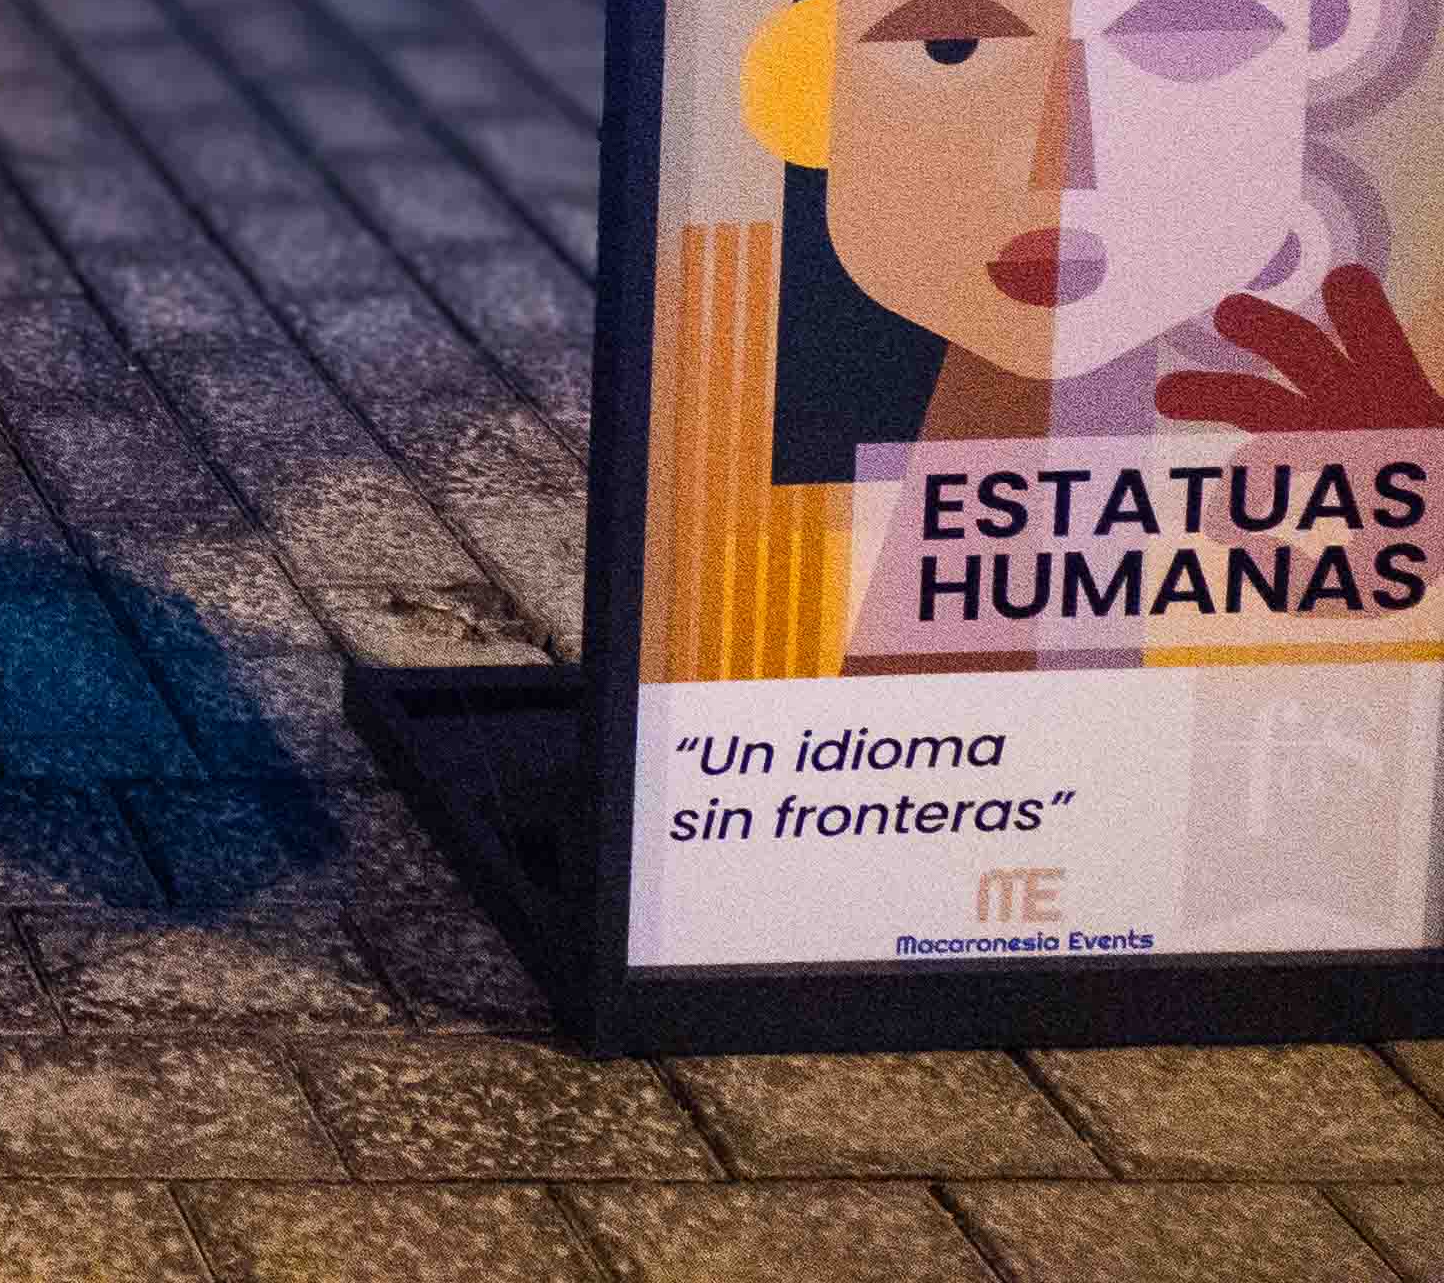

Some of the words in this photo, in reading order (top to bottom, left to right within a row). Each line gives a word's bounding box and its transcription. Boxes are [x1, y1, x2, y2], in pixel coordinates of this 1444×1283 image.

[922, 462, 1428, 540] ESTATUAS
[918, 543, 1428, 621] HUMANAS
[796, 728, 1006, 772] idioma
[669, 798, 753, 842] sin
[895, 932, 1061, 956] Macaronesia
[1068, 928, 1155, 952] Events
